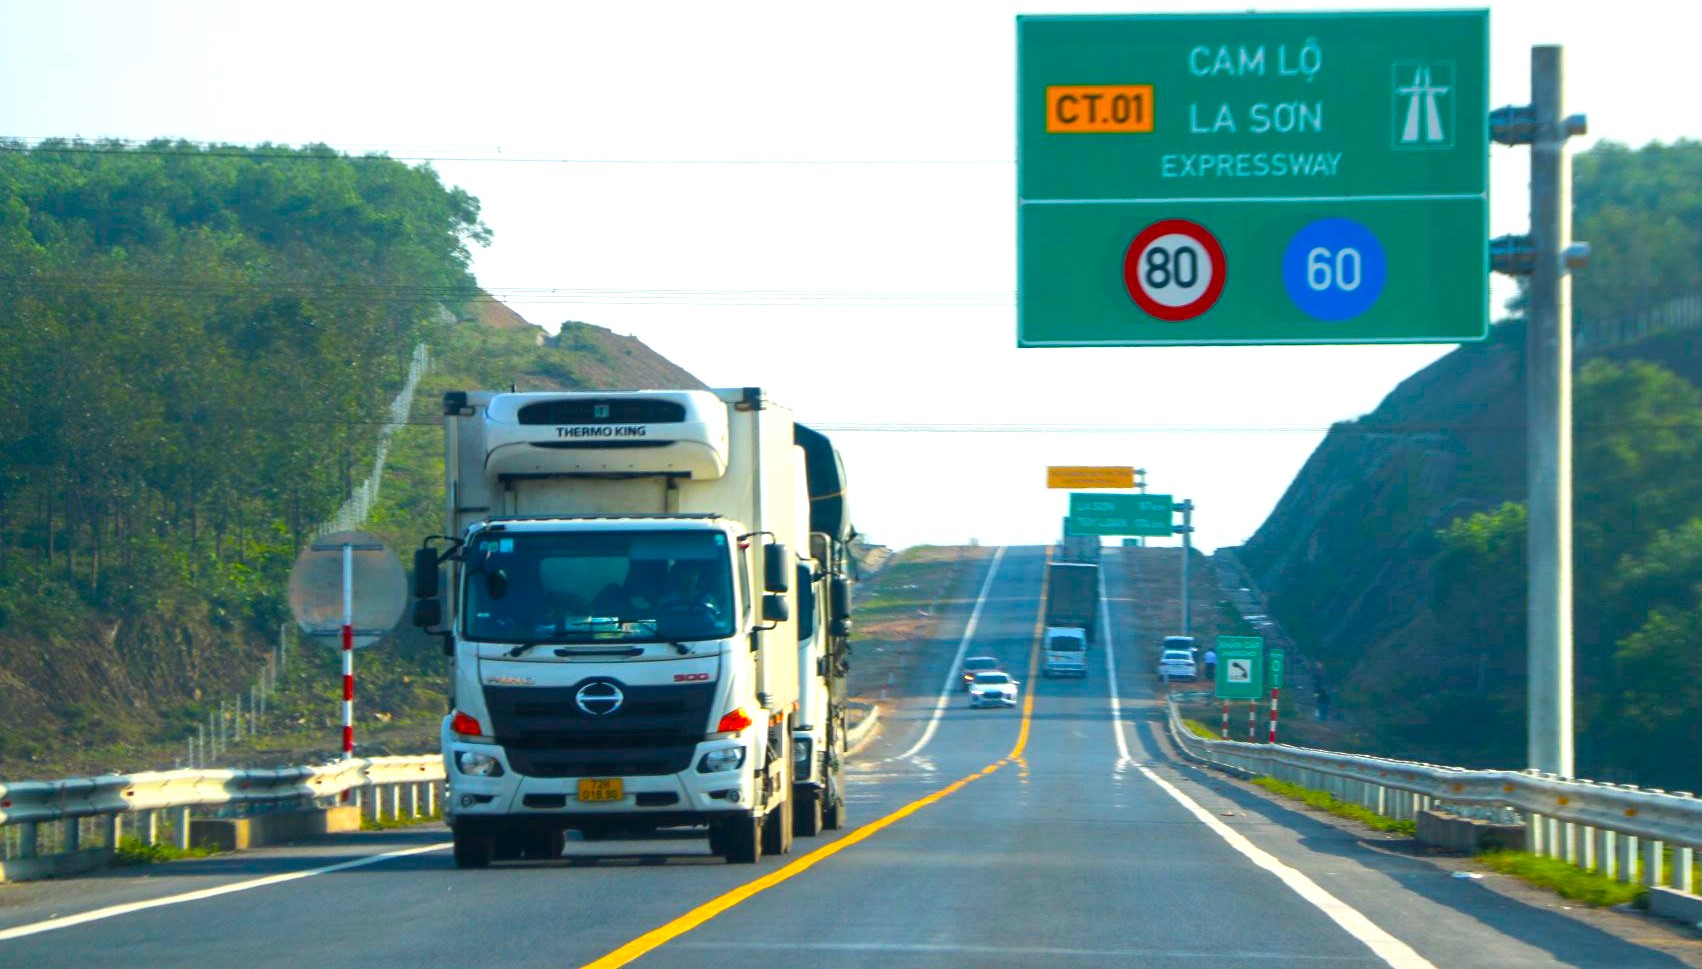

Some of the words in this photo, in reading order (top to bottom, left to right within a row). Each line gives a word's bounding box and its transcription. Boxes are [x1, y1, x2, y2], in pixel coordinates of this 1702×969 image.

[1189, 45, 1265, 77] CAM
[1278, 37, 1321, 83] LỘ
[1055, 95, 1145, 125] CT.01
[1189, 104, 1235, 133] LA
[1249, 101, 1323, 133] SƠN
[1161, 153, 1342, 178] EXPRESSWAY
[1146, 247, 1198, 289] 80
[1307, 248, 1362, 291] 60
[556, 426, 612, 437] THERMO
[615, 425, 646, 436] KING
